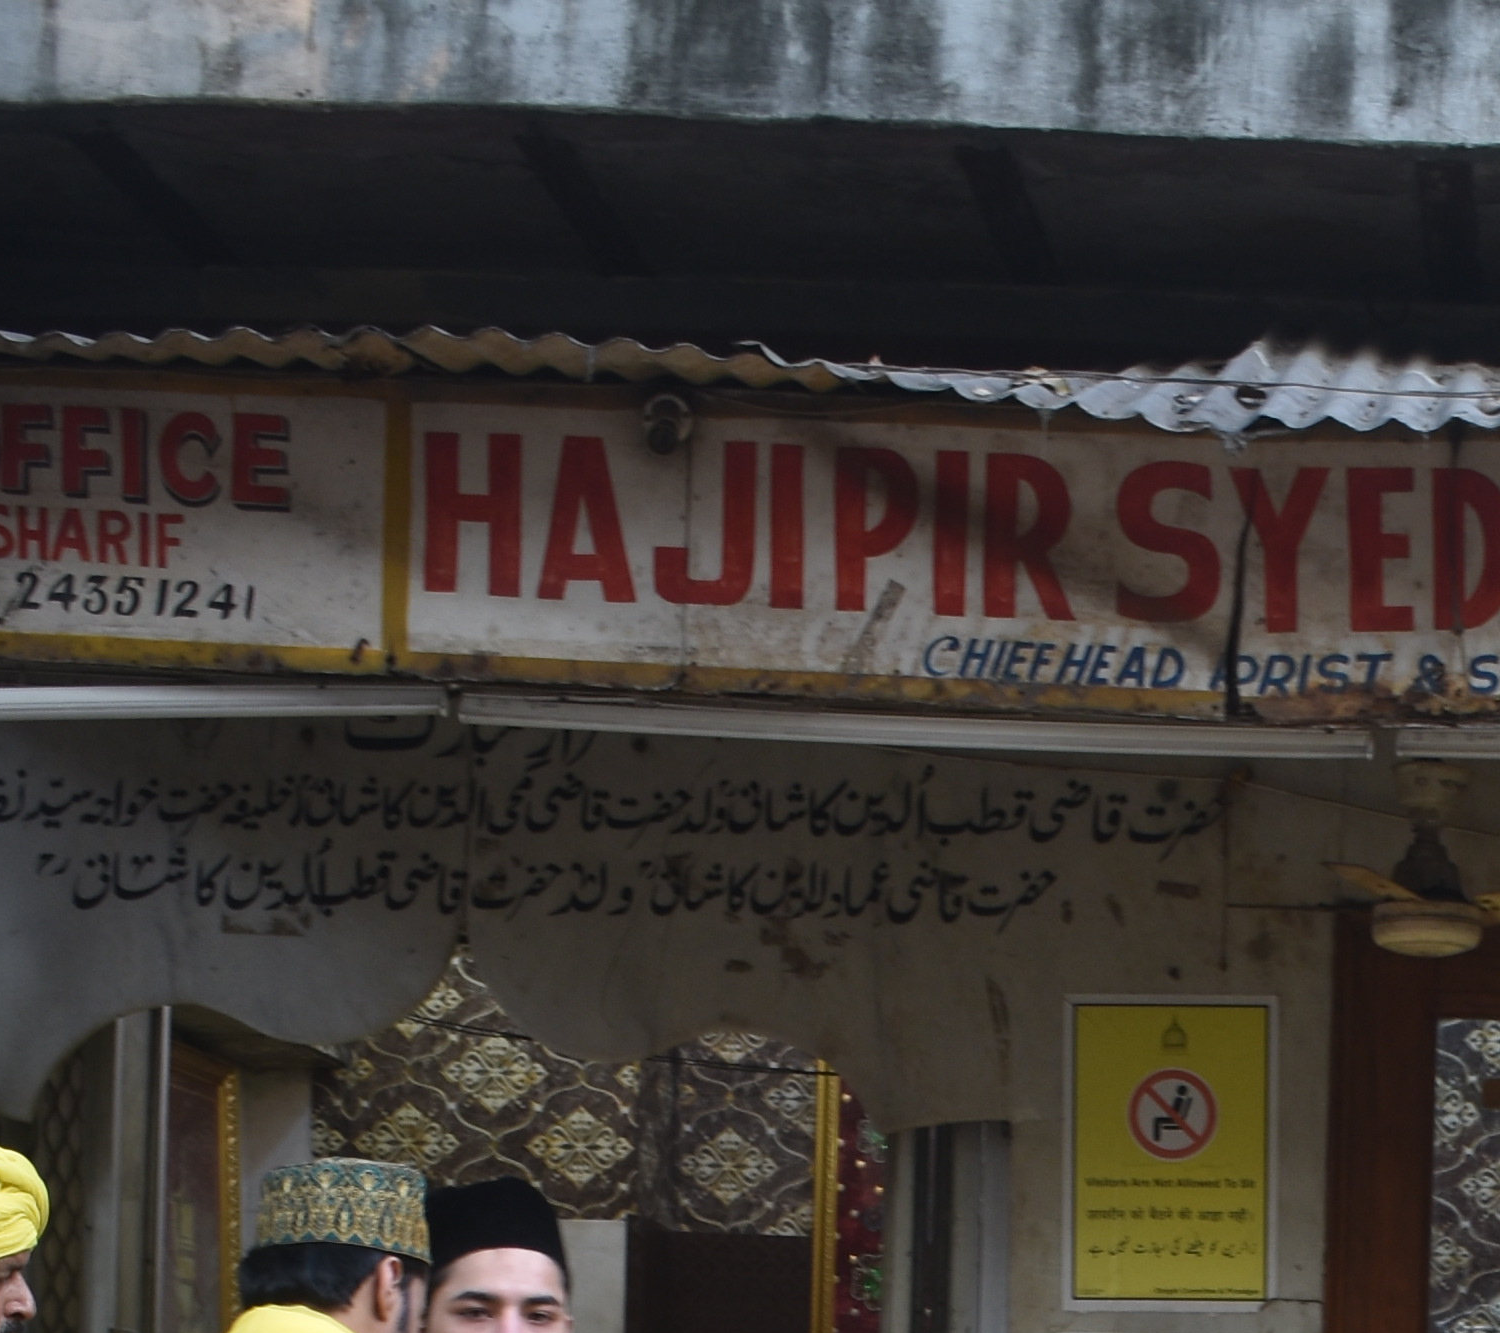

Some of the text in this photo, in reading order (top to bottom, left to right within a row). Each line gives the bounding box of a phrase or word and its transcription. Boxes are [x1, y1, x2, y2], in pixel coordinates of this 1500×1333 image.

[423, 432, 804, 609] HAJI
[835, 447, 1075, 621] PIR
[15, 571, 256, 620] 24351241
